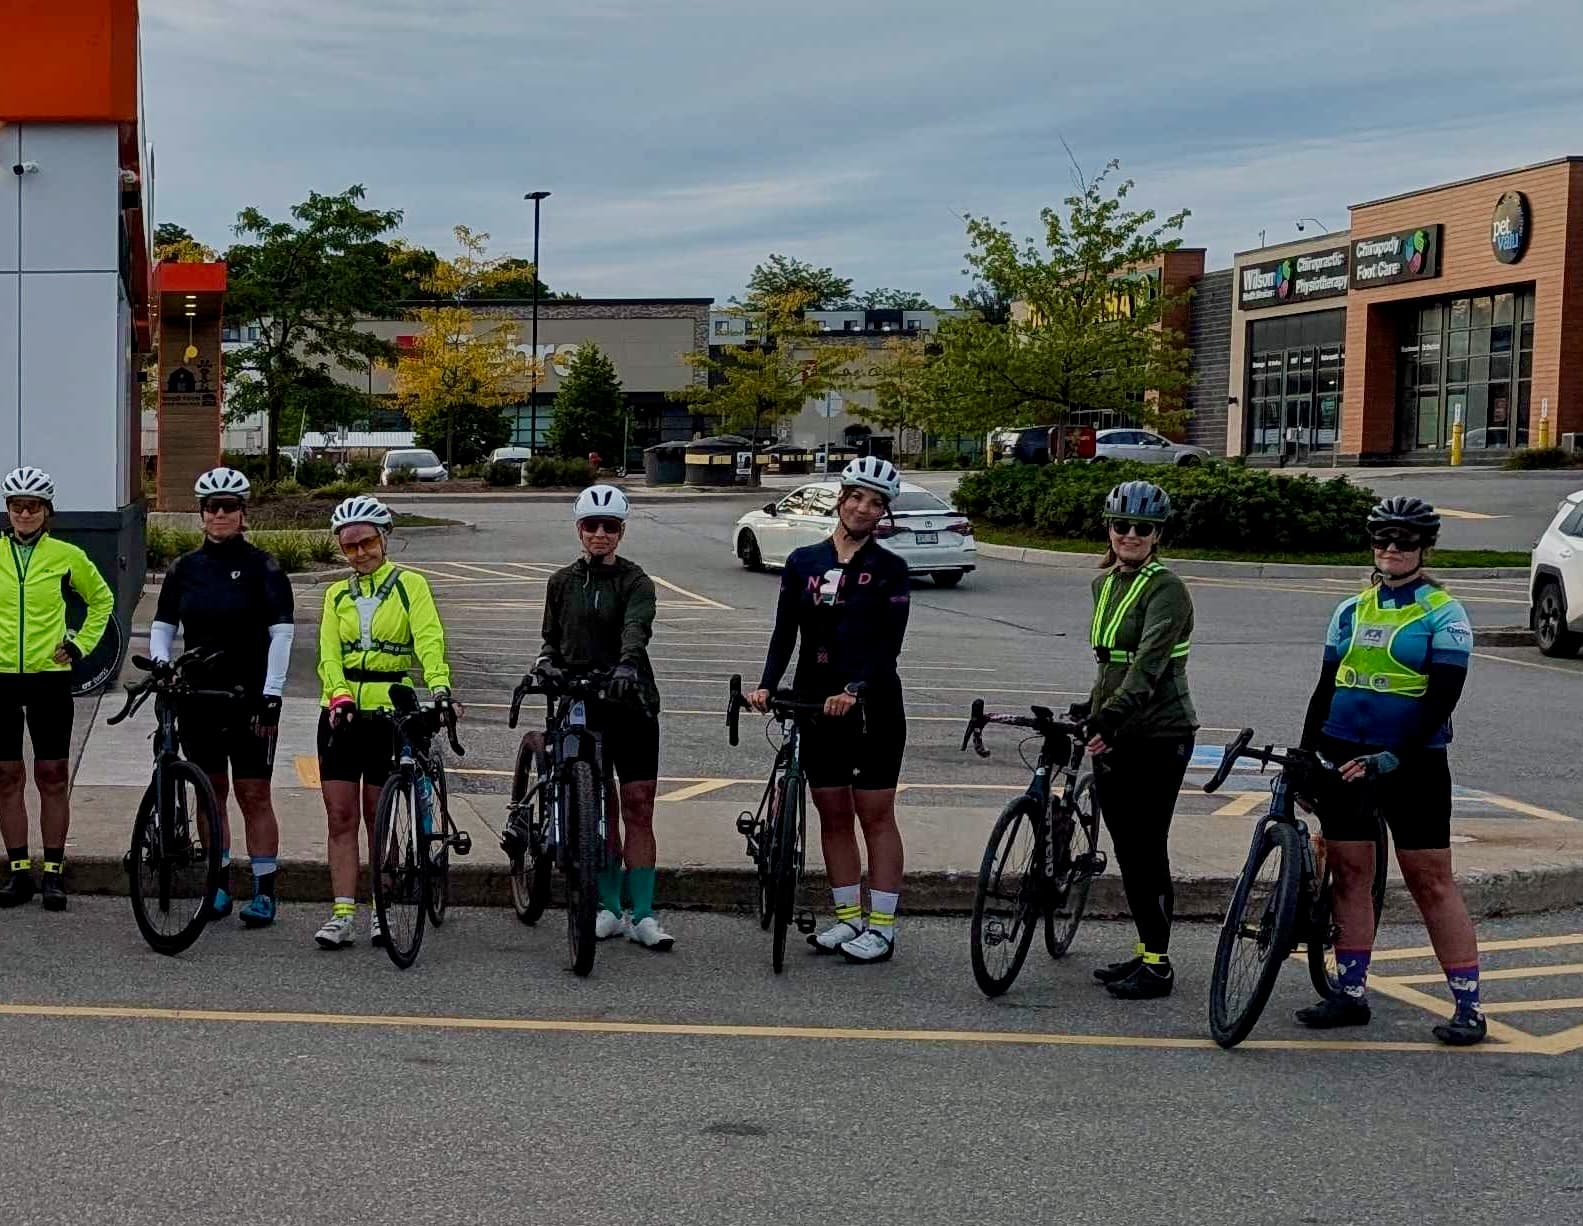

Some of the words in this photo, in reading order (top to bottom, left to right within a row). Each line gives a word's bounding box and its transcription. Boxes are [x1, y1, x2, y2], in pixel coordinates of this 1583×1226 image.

[1493, 216, 1511, 242] pet
[1356, 236, 1400, 258] Chiropody
[1296, 252, 1345, 273] Chiropractic
[1357, 264, 1377, 280] Foot
[1377, 261, 1401, 278] Care
[1243, 268, 1276, 291] Wilson
[1296, 275, 1349, 296] Physiotherapy
